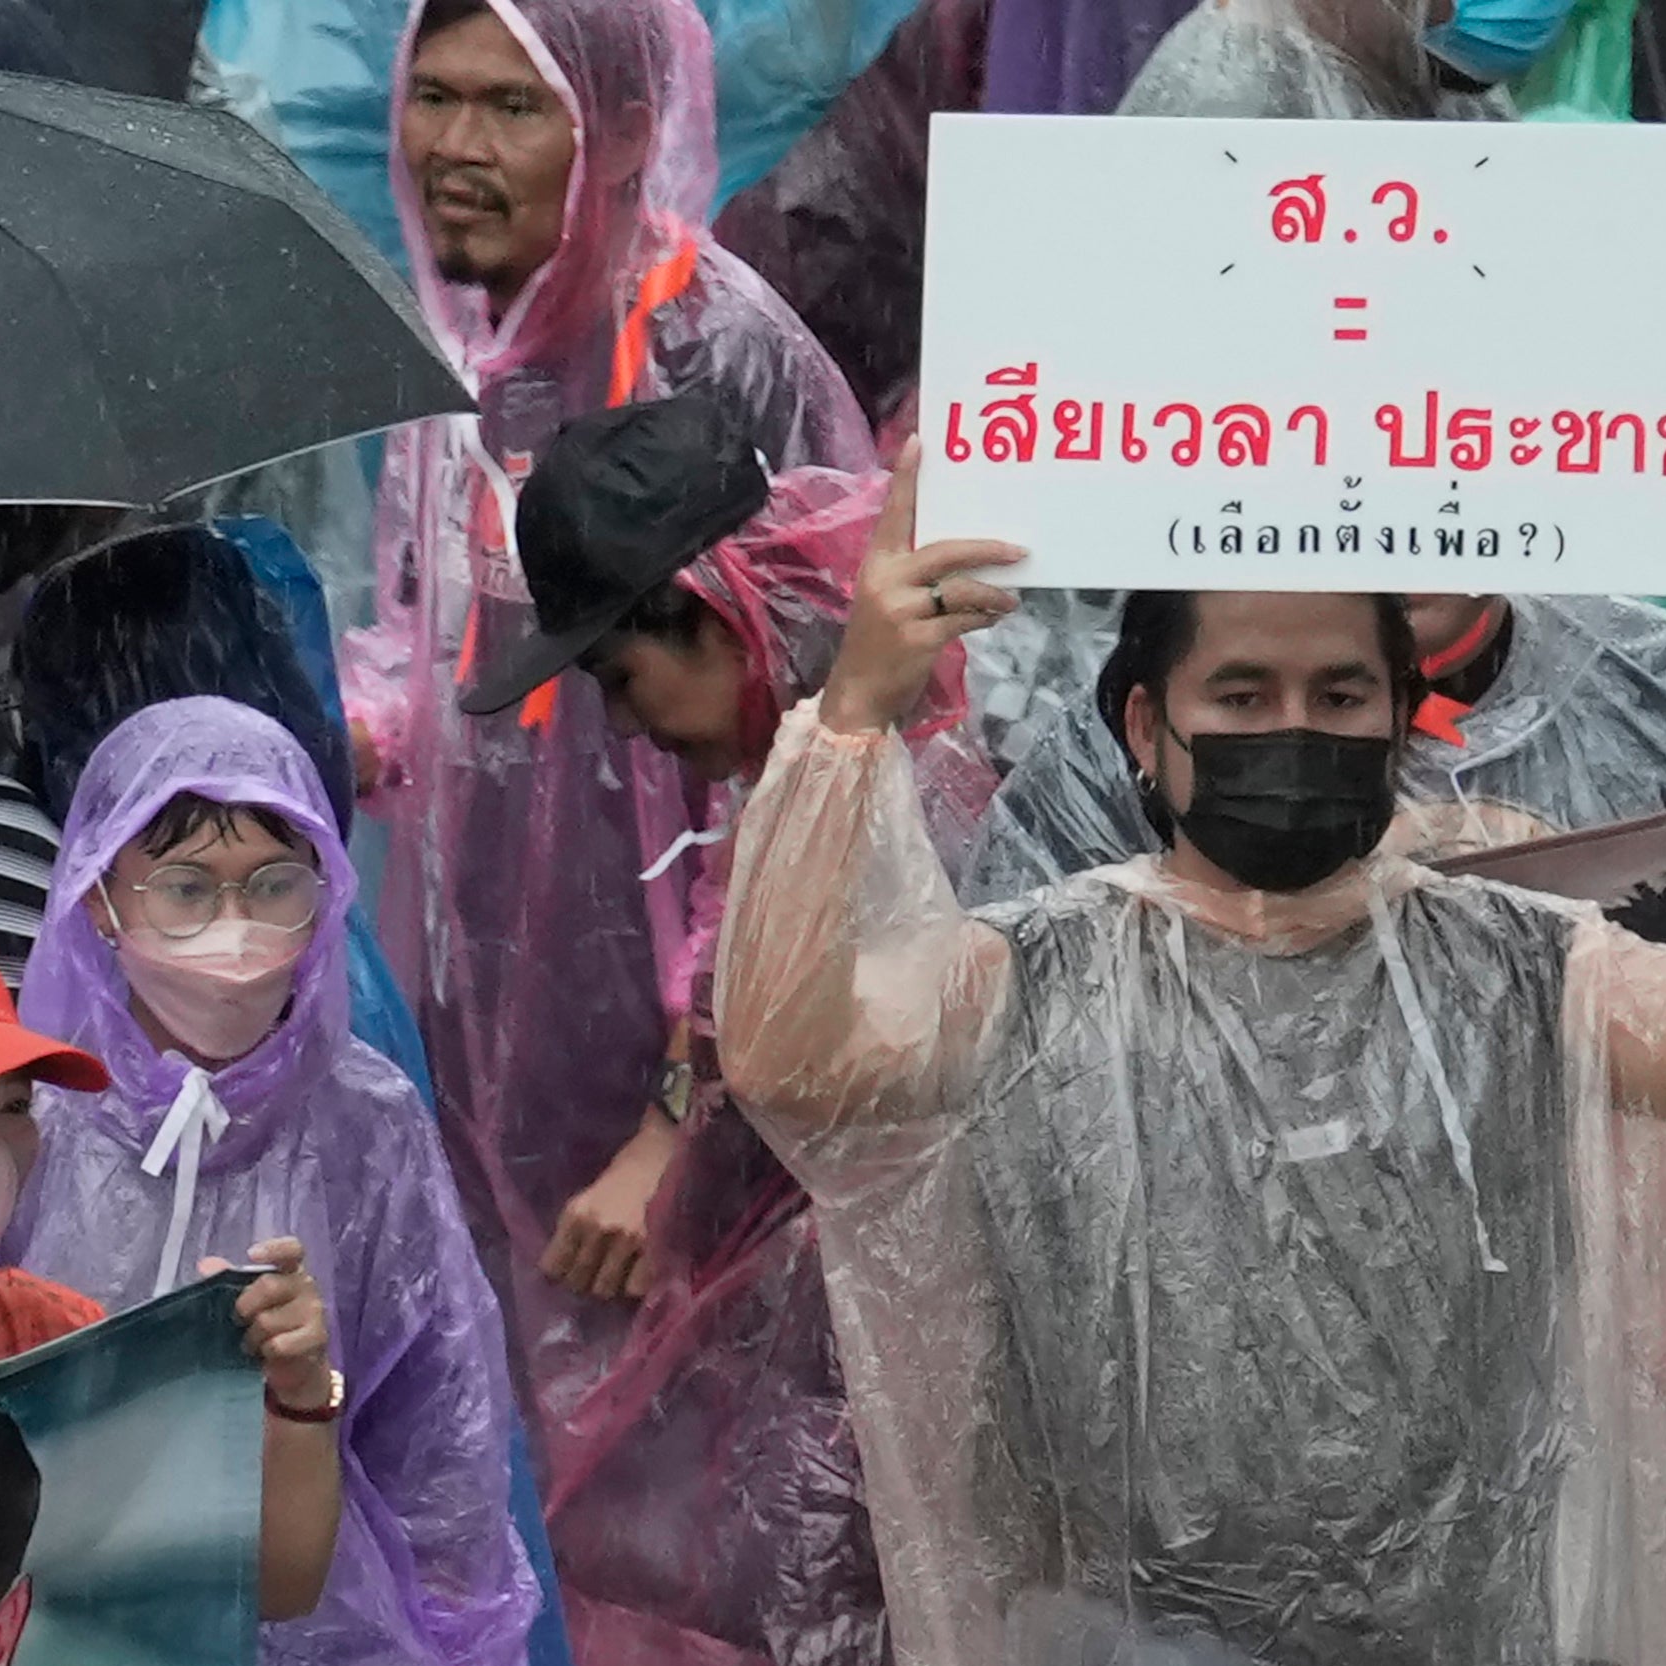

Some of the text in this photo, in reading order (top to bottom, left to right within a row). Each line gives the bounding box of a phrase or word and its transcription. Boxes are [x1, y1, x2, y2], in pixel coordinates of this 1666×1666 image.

[1269, 173, 1449, 244] ส.ว.
[1334, 296, 1369, 341] =
[944, 361, 1329, 468] เสียเวลา
[1168, 475, 1566, 562] (เลือกตั้งเพื่อ?)
